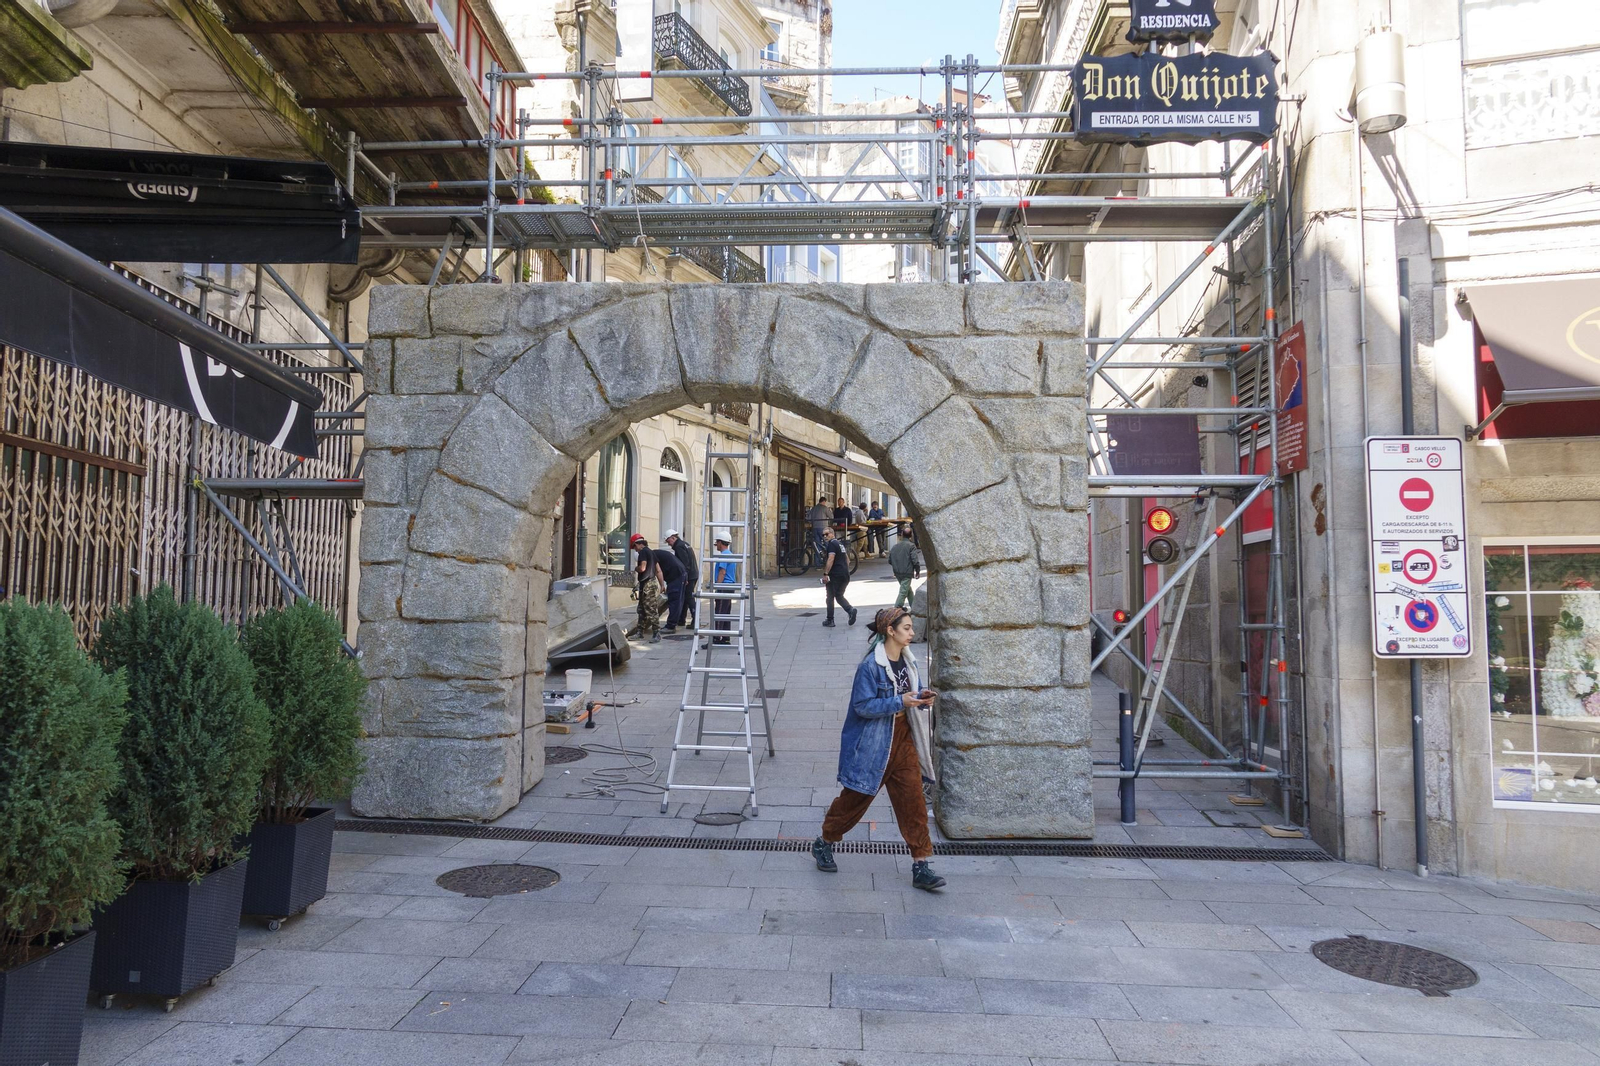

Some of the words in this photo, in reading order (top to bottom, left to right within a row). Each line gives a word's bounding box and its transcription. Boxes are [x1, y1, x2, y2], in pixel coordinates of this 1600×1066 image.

[1140, 13, 1211, 29] RESIDENCIA
[1082, 63, 1141, 101] Don
[1151, 61, 1270, 108] Quijote
[1099, 114, 1140, 125] ENTRADA
[1142, 114, 1160, 125] POR
[1162, 114, 1174, 125] LA
[1176, 114, 1205, 125] MISMA
[1207, 114, 1235, 125] CALLE
